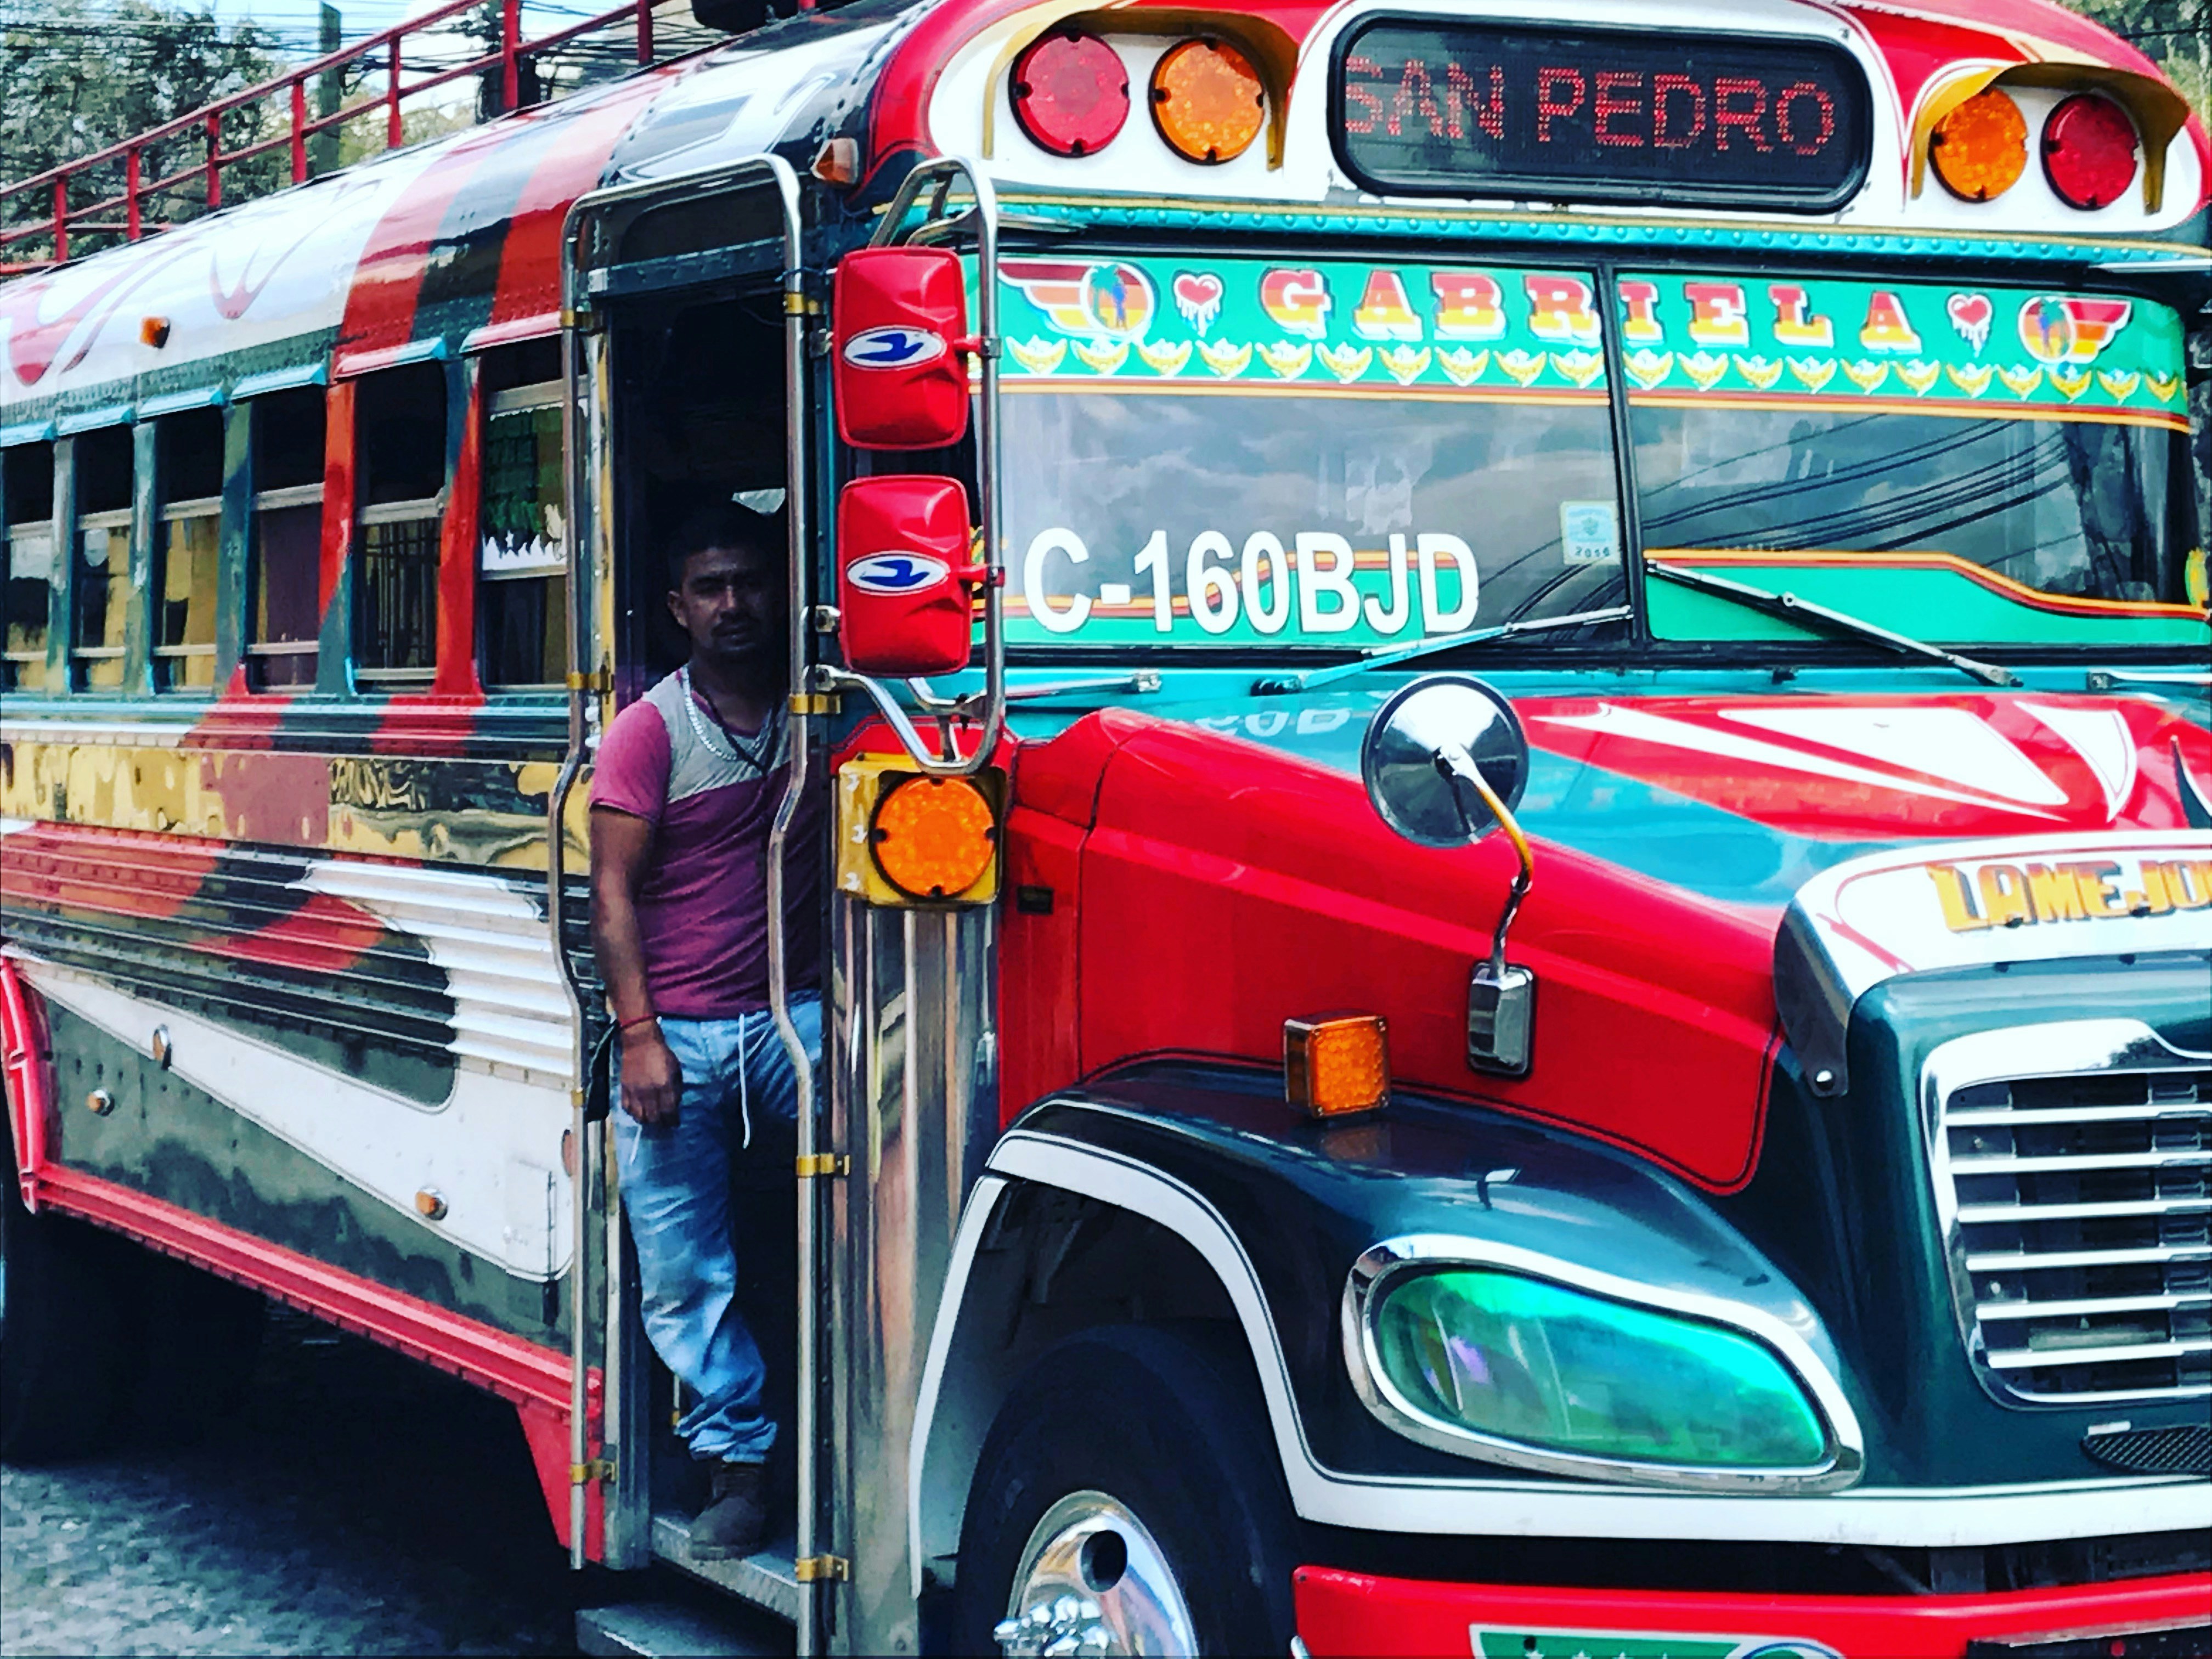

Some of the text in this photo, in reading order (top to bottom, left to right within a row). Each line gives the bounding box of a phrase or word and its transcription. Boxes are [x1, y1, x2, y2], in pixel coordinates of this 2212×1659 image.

[1345, 57, 1834, 156] SAN PEDRO
[1260, 268, 1922, 354] GABRIELA
[1024, 528, 1479, 634] C-160BJD
[1925, 860, 2212, 933] LAMEJO
